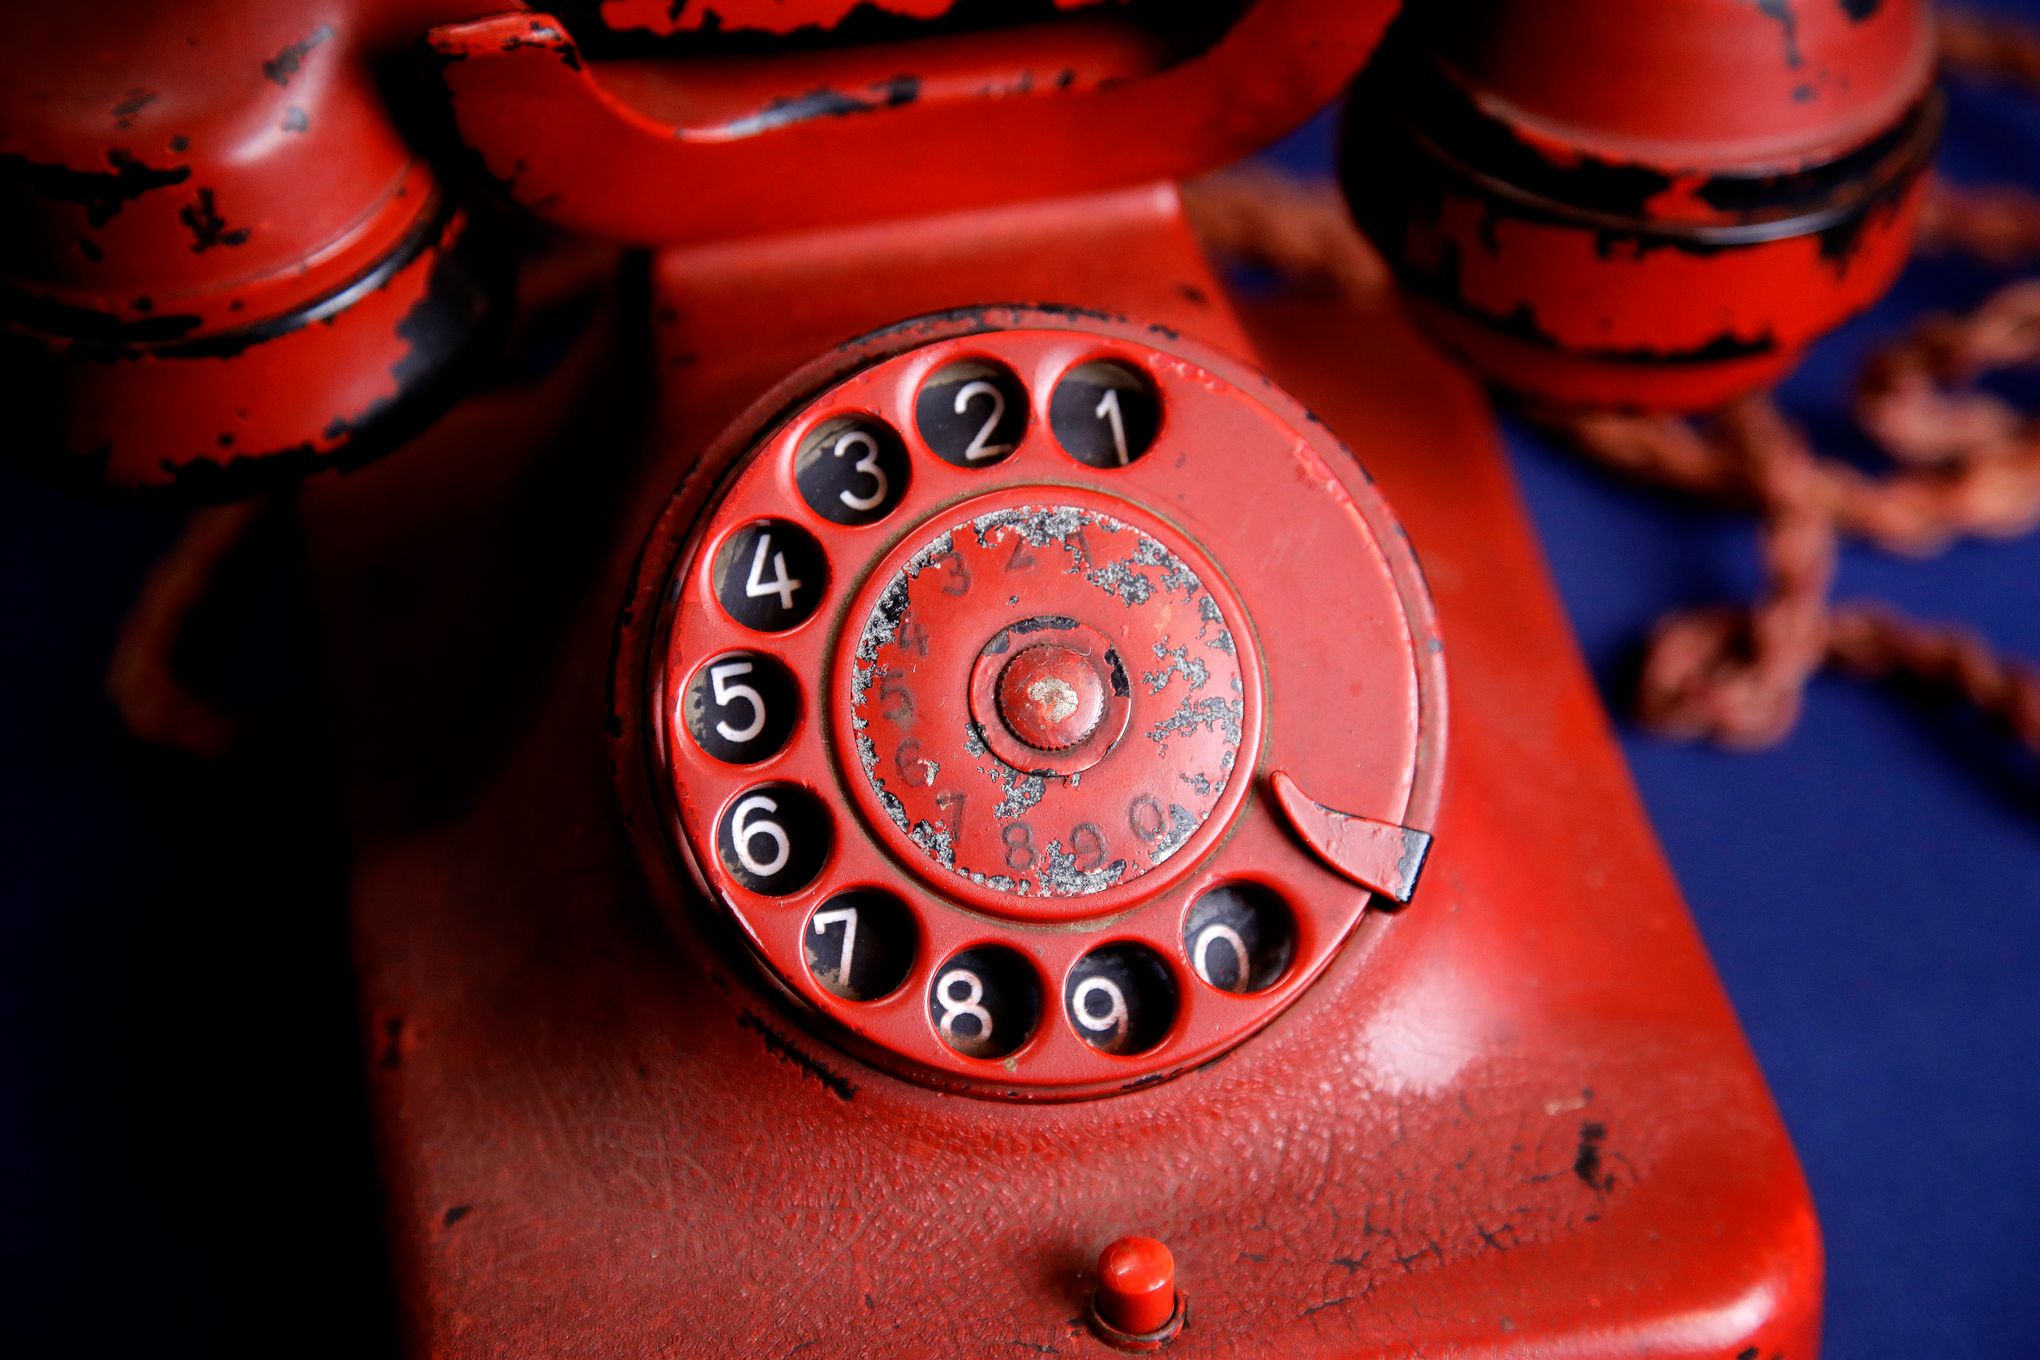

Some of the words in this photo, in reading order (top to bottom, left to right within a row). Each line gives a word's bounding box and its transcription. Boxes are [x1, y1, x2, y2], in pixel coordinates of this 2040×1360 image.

[954, 381, 1012, 460] 2
[1094, 388, 1129, 466] 1
[834, 430, 888, 511] 3
[745, 533, 801, 610] 4
[937, 551, 972, 596] 3
[710, 662, 766, 743] 5
[731, 795, 790, 877] 6
[936, 792, 968, 843] 7
[1003, 822, 1037, 870] 8
[1069, 822, 1106, 869] 9
[1128, 793, 1166, 841] 0
[812, 907, 858, 988] 7
[1194, 923, 1249, 994] 0
[936, 969, 993, 1044] 8
[1072, 976, 1128, 1051] 9
